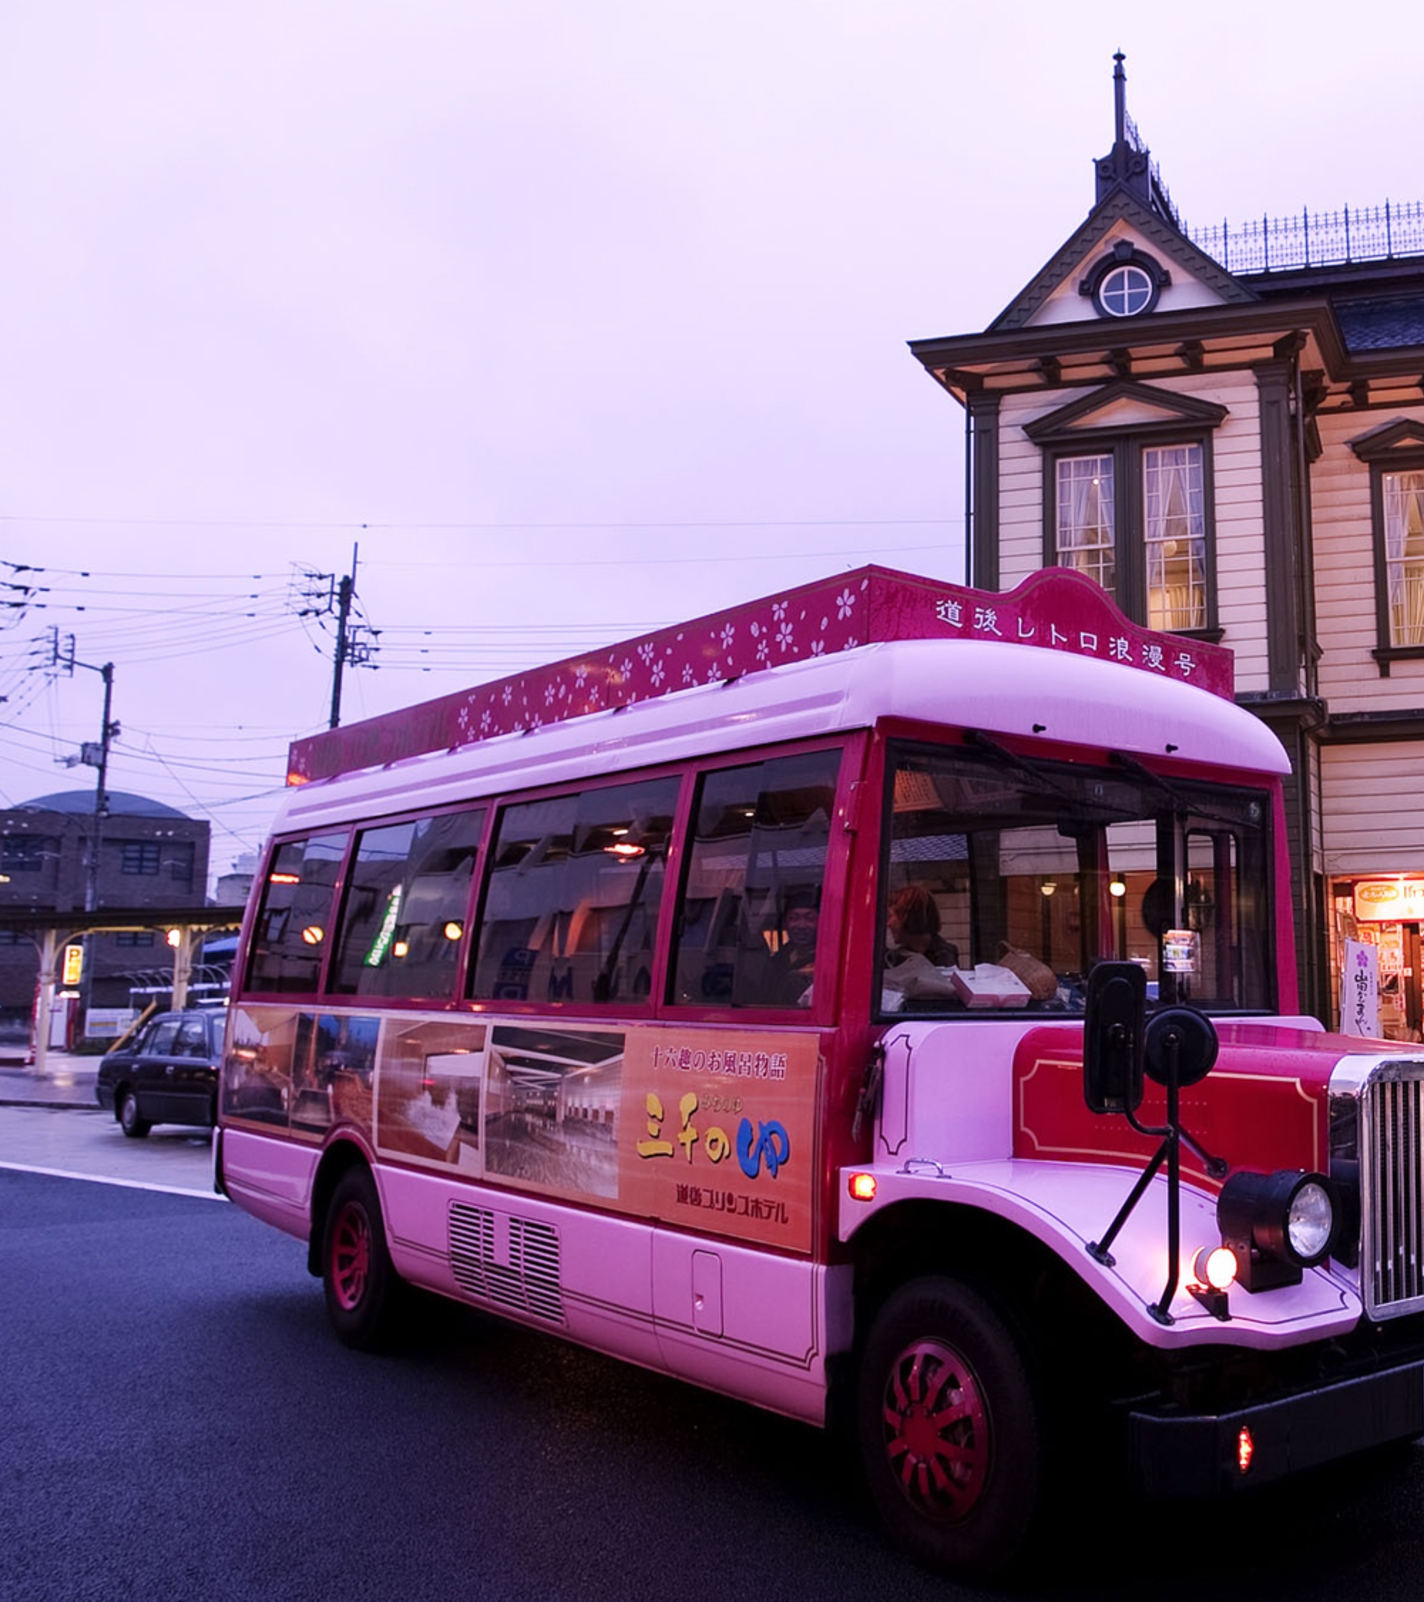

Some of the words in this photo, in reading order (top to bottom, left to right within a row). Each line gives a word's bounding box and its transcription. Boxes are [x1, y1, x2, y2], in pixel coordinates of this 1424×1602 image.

[936, 599, 1196, 677] 道後レトロ浪漫号
[676, 1184, 789, 1224] 道後プリンスホテル
